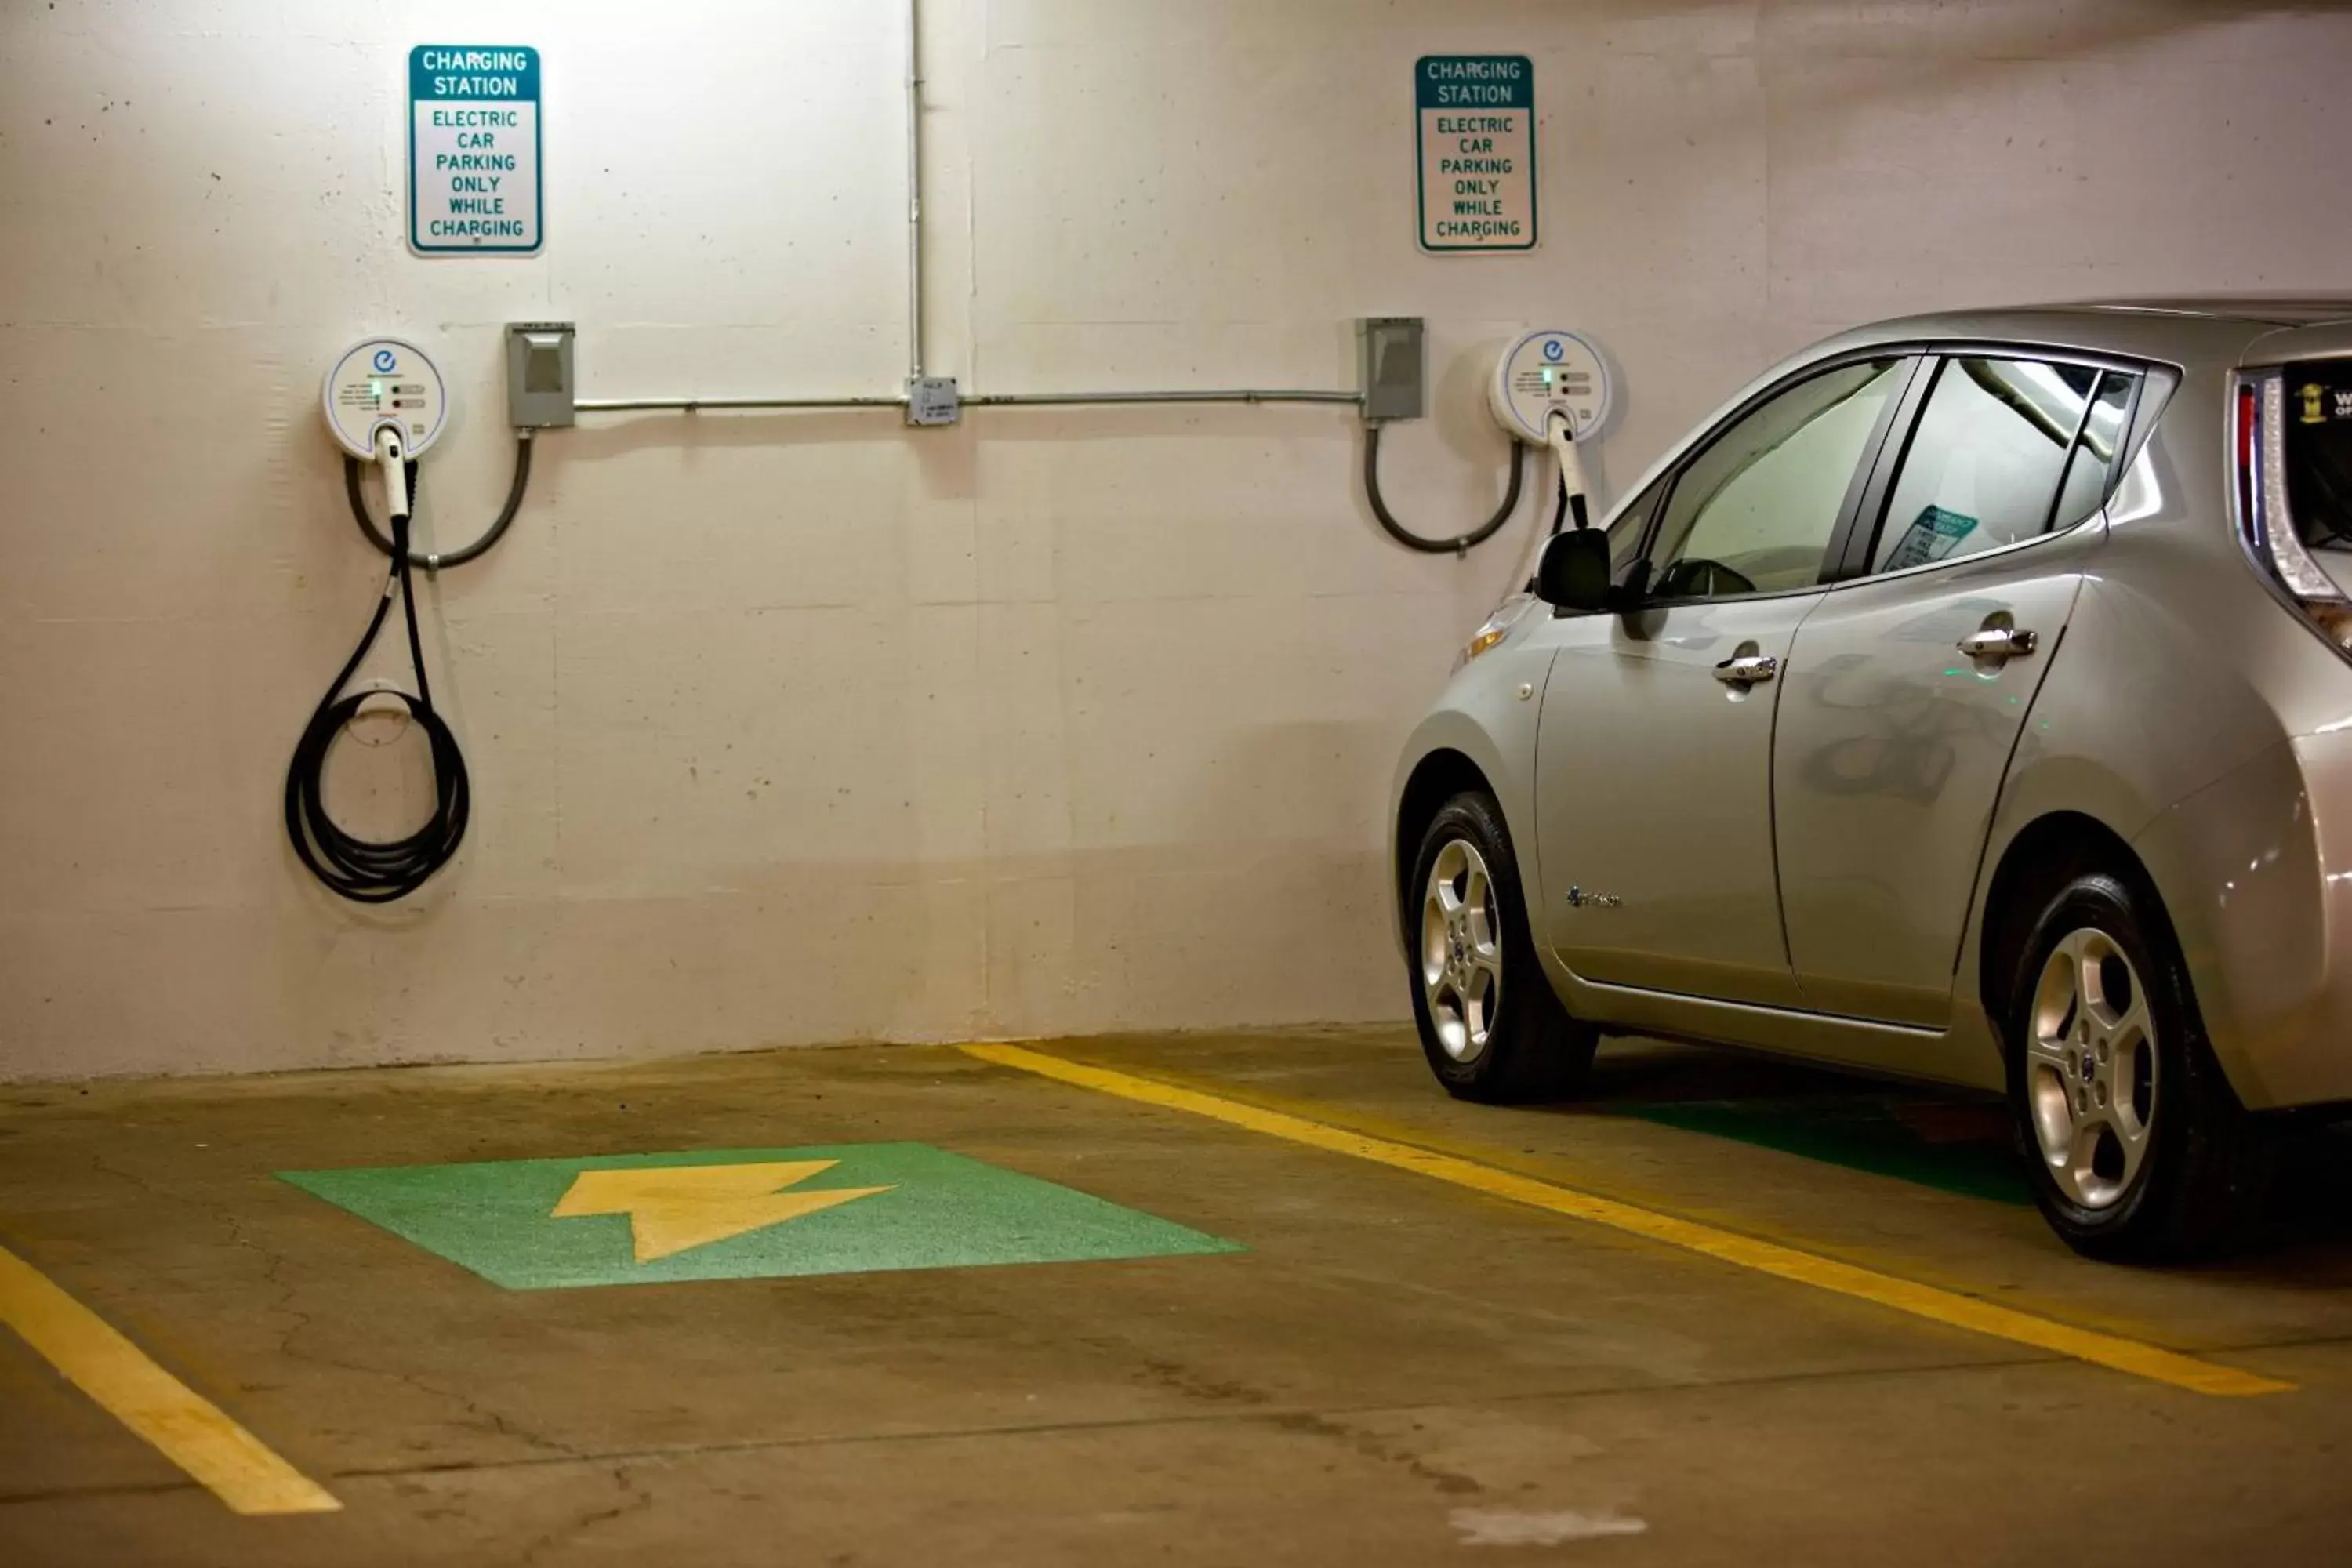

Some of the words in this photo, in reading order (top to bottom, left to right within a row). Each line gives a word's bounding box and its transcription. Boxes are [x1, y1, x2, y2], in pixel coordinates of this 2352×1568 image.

[423, 51, 527, 71] CHARGING
[1428, 62, 1520, 80] CHARGING
[434, 76, 517, 96] STATION
[1438, 85, 1512, 103] STATION
[433, 111, 517, 127] ELECTRIC
[1437, 117, 1512, 134] ELECTRIC
[457, 132, 494, 149] CAR
[1459, 138, 1493, 154] CAR
[437, 154, 515, 171] PARKING
[1441, 158, 1512, 174] PARKING
[451, 176, 500, 192] ONLY
[1455, 180, 1499, 195] ONLY
[449, 198, 503, 215] WHILE
[1454, 200, 1501, 216] WHILE
[430, 220, 524, 237] CHARGING
[1436, 220, 1520, 237] CHARGING
